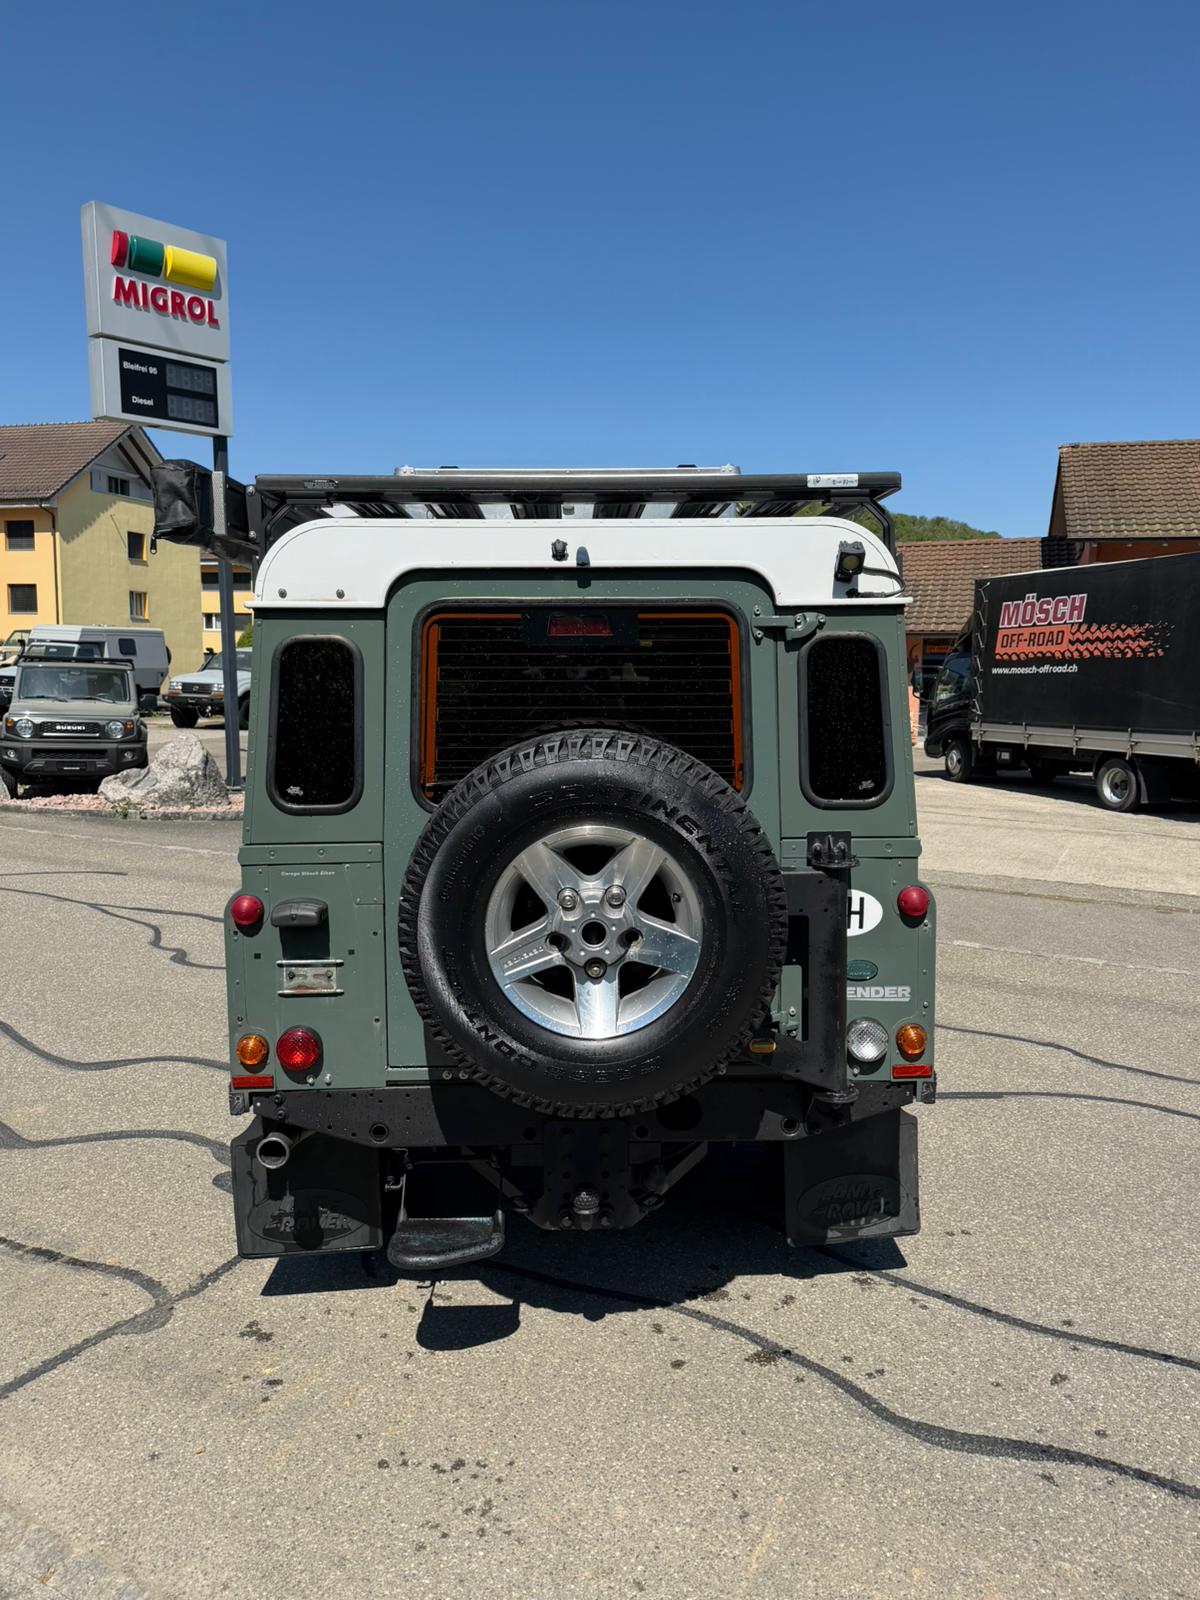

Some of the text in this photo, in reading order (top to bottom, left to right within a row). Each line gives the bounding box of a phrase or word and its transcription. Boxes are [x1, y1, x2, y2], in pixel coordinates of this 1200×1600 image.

[113, 276, 220, 326] MIGROL
[122, 361, 147, 374] Bleifrei
[131, 396, 154, 406] Diesel
[999, 593, 1088, 628] MÖSCH
[1000, 630, 1065, 648] OFF-ROAD
[847, 896, 865, 929] H
[847, 986, 911, 998] ENDER
